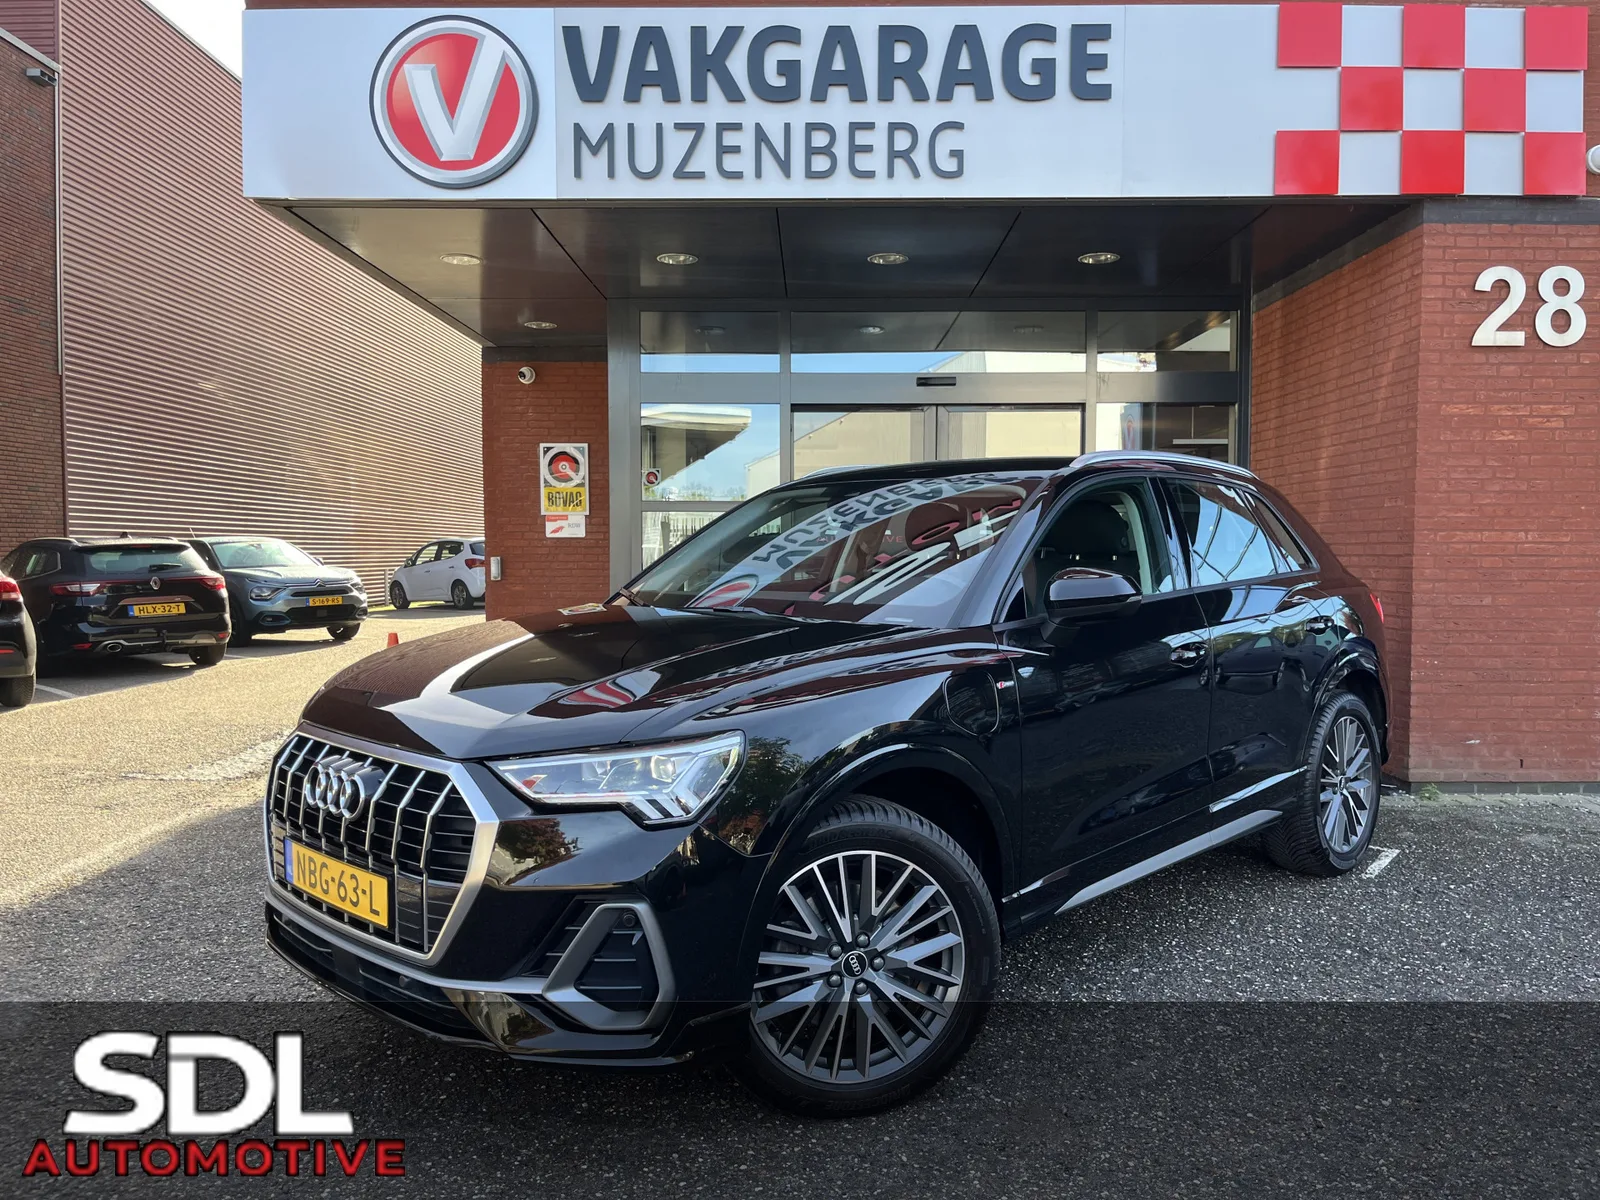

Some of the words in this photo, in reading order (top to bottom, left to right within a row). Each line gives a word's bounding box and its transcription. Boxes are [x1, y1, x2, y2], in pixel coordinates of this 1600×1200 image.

[561, 23, 1112, 102] VAKGARAGE
[573, 121, 965, 180] MUZENBERG
[1471, 265, 1587, 347] 28
[547, 491, 583, 508] BOVAG
[138, 604, 181, 614] HLX-32-T
[296, 850, 380, 917] NBG-63-L
